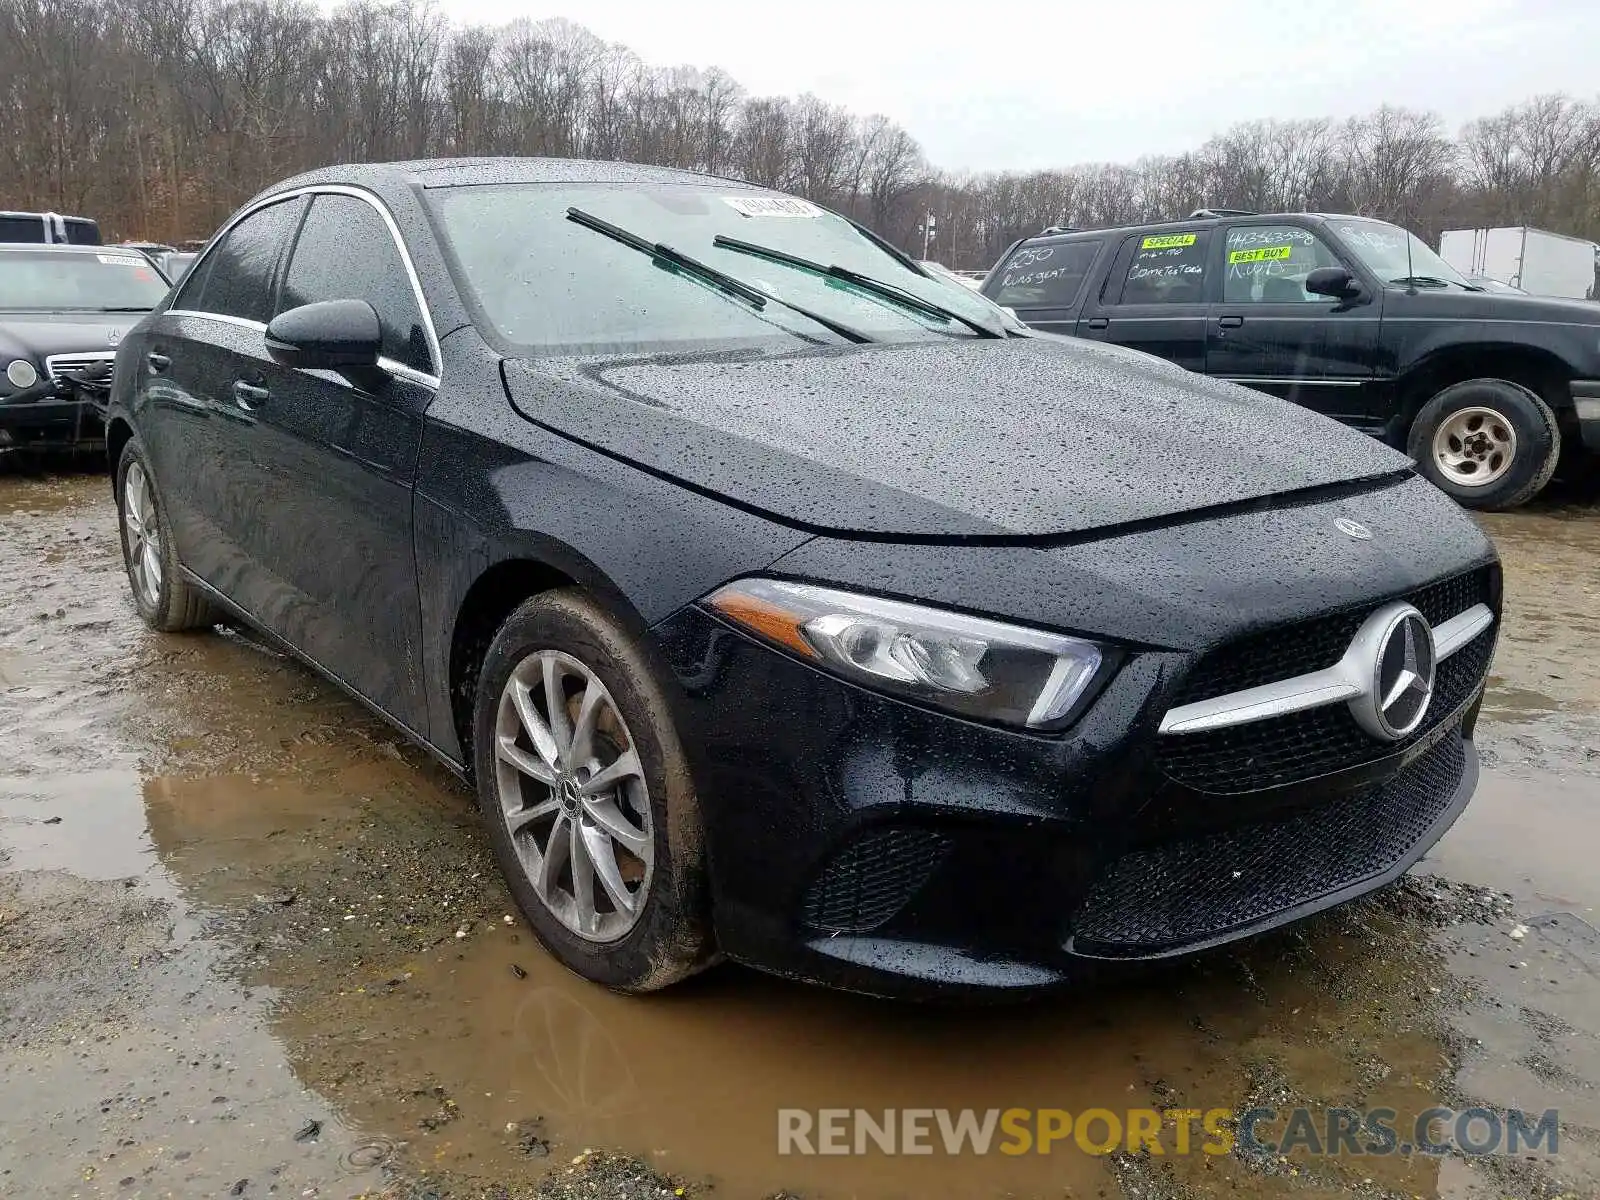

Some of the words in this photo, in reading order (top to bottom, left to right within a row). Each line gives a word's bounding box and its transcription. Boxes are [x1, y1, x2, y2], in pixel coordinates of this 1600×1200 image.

[1147, 235, 1194, 247] SPECIAL
[1234, 250, 1260, 261] BEST
[1263, 247, 1286, 259] BUY
